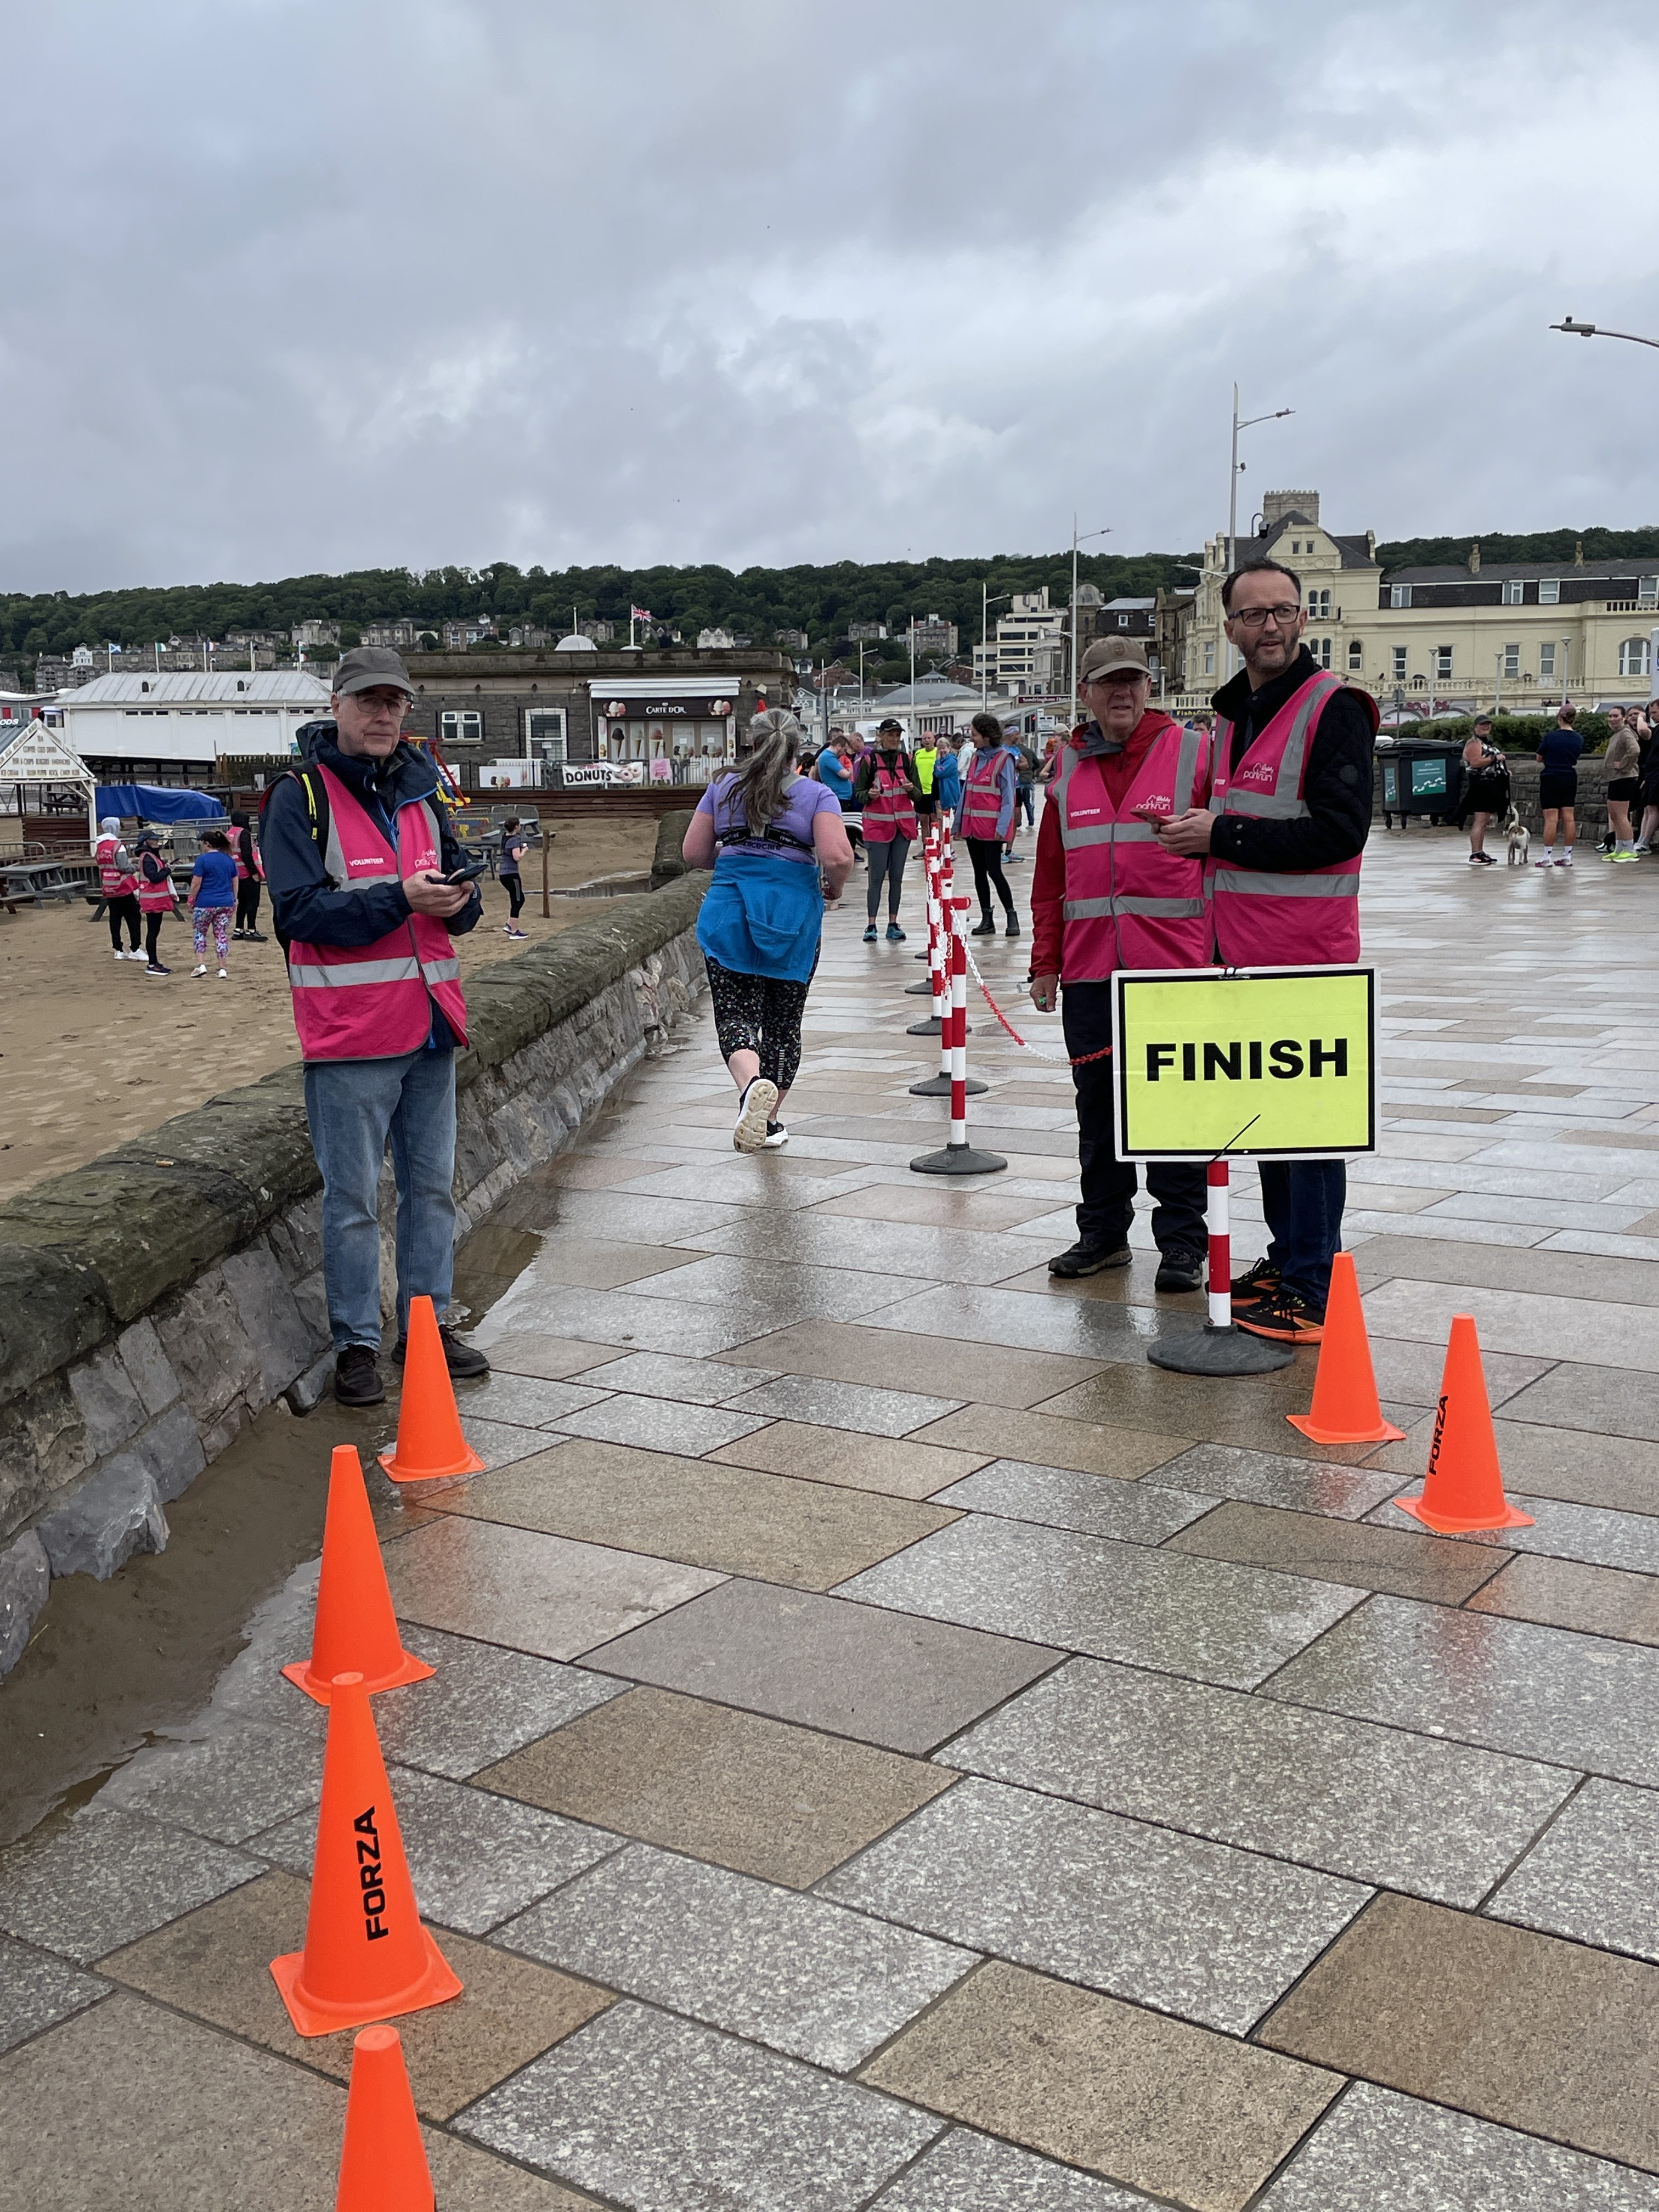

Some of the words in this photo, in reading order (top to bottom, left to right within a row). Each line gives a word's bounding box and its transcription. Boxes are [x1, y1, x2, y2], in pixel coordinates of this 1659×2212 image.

[646, 706, 667, 714] CARTE
[566, 770, 612, 783] DONUTS
[1070, 808, 1101, 818] VOLUNTEER
[349, 857, 384, 867] VOLUNTEER
[1146, 1038, 1348, 1082] FINISH
[1429, 1395, 1448, 1476] FORZA
[353, 1805, 389, 1941] FORZA
